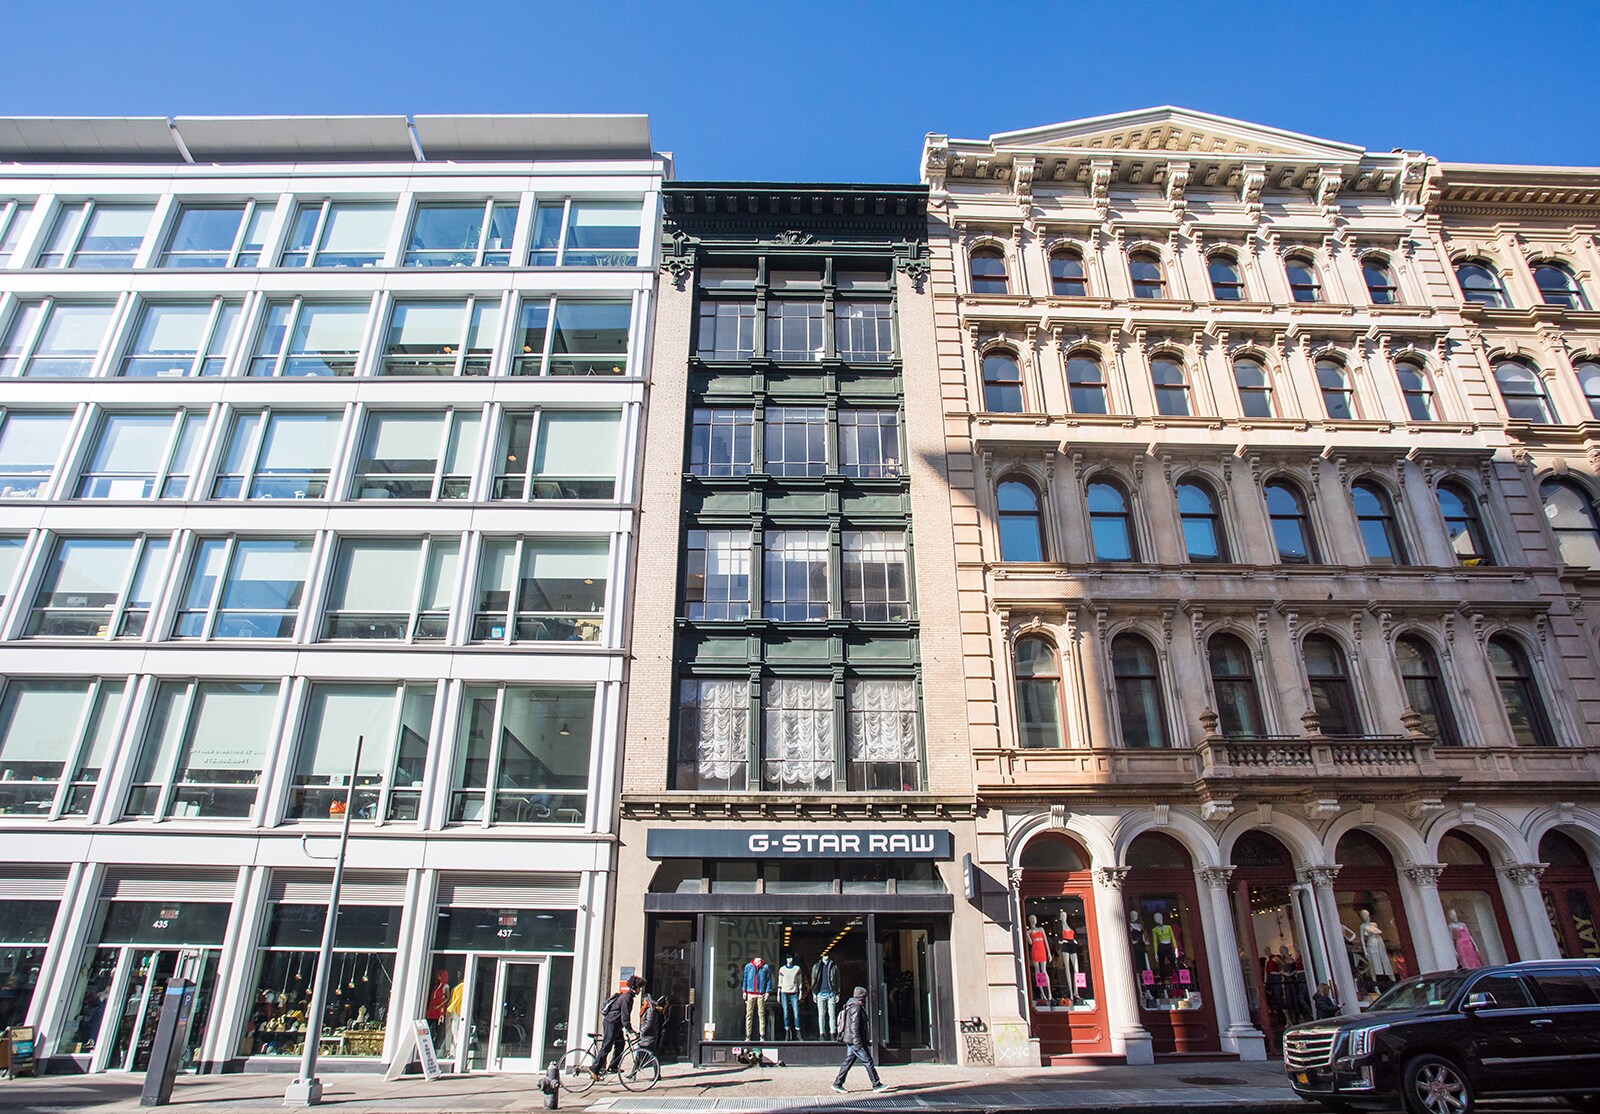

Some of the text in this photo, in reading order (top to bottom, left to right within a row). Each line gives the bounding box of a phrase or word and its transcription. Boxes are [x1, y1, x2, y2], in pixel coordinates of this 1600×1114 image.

[748, 834, 935, 853] G-STAR RAW
[152, 919, 169, 929] 435
[497, 929, 513, 938] 437
[1572, 913, 1600, 958] LAY
[662, 948, 684, 960] 441
[184, 994, 191, 1006] P
